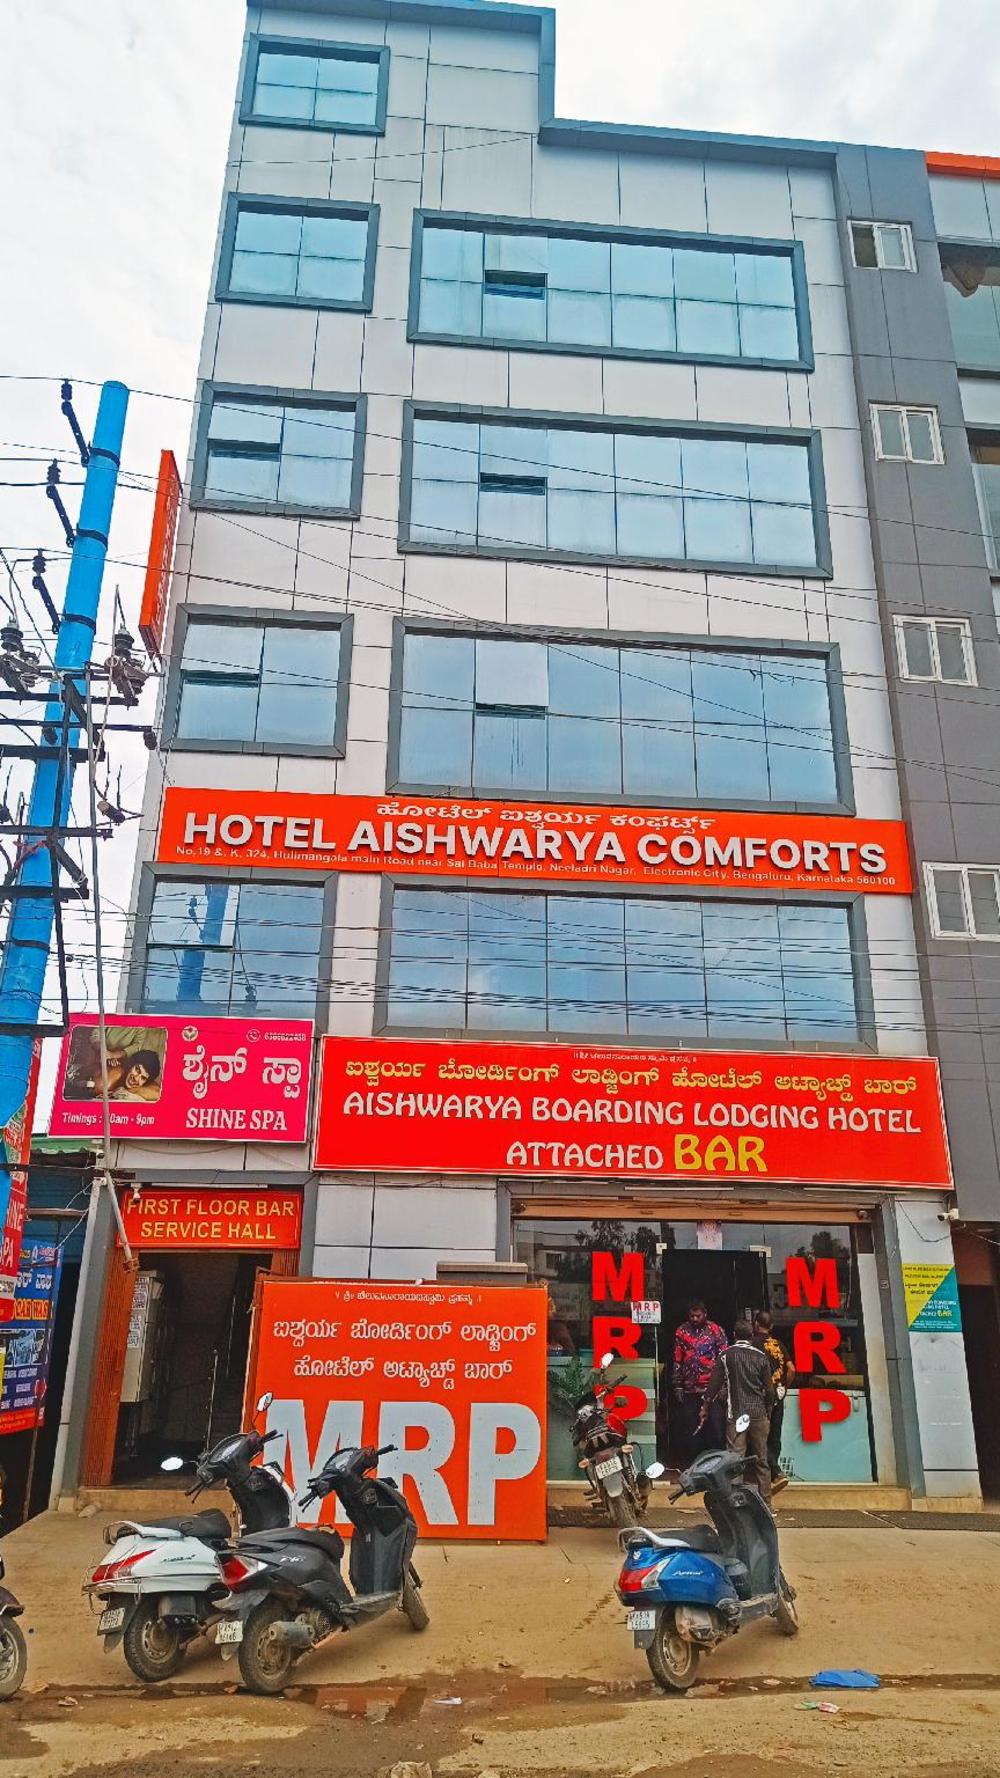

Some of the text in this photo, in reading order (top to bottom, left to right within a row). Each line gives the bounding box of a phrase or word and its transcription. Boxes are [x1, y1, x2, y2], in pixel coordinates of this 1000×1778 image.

[183, 812, 887, 873] HOTEL AISHWARYA COMFORTS
[384, 855, 414, 867] Road
[644, 866, 700, 878] Electronic
[797, 873, 854, 884] Karnataka
[182, 1044, 302, 1099] ಶೈನ್ ಸ್ಪಾ
[672, 1066, 763, 1089] ಹೋಟೆಲ್
[864, 1076, 917, 1095] ಬಾರ್
[186, 1108, 287, 1131] SHINE SPA
[343, 1091, 922, 1133] AISHWARYA BOARDING LODGING HOTEL
[506, 1134, 768, 1173] ATTACHED BAR
[127, 1198, 295, 1217] FIRST FLOOR BAR
[140, 1221, 276, 1240] SERVICE HALL
[294, 1355, 375, 1377] ಹೋಟೆಲ್
[464, 1359, 514, 1380] ಬಾರ್
[785, 1257, 851, 1444] MRP
[262, 1399, 541, 1526] MRP
